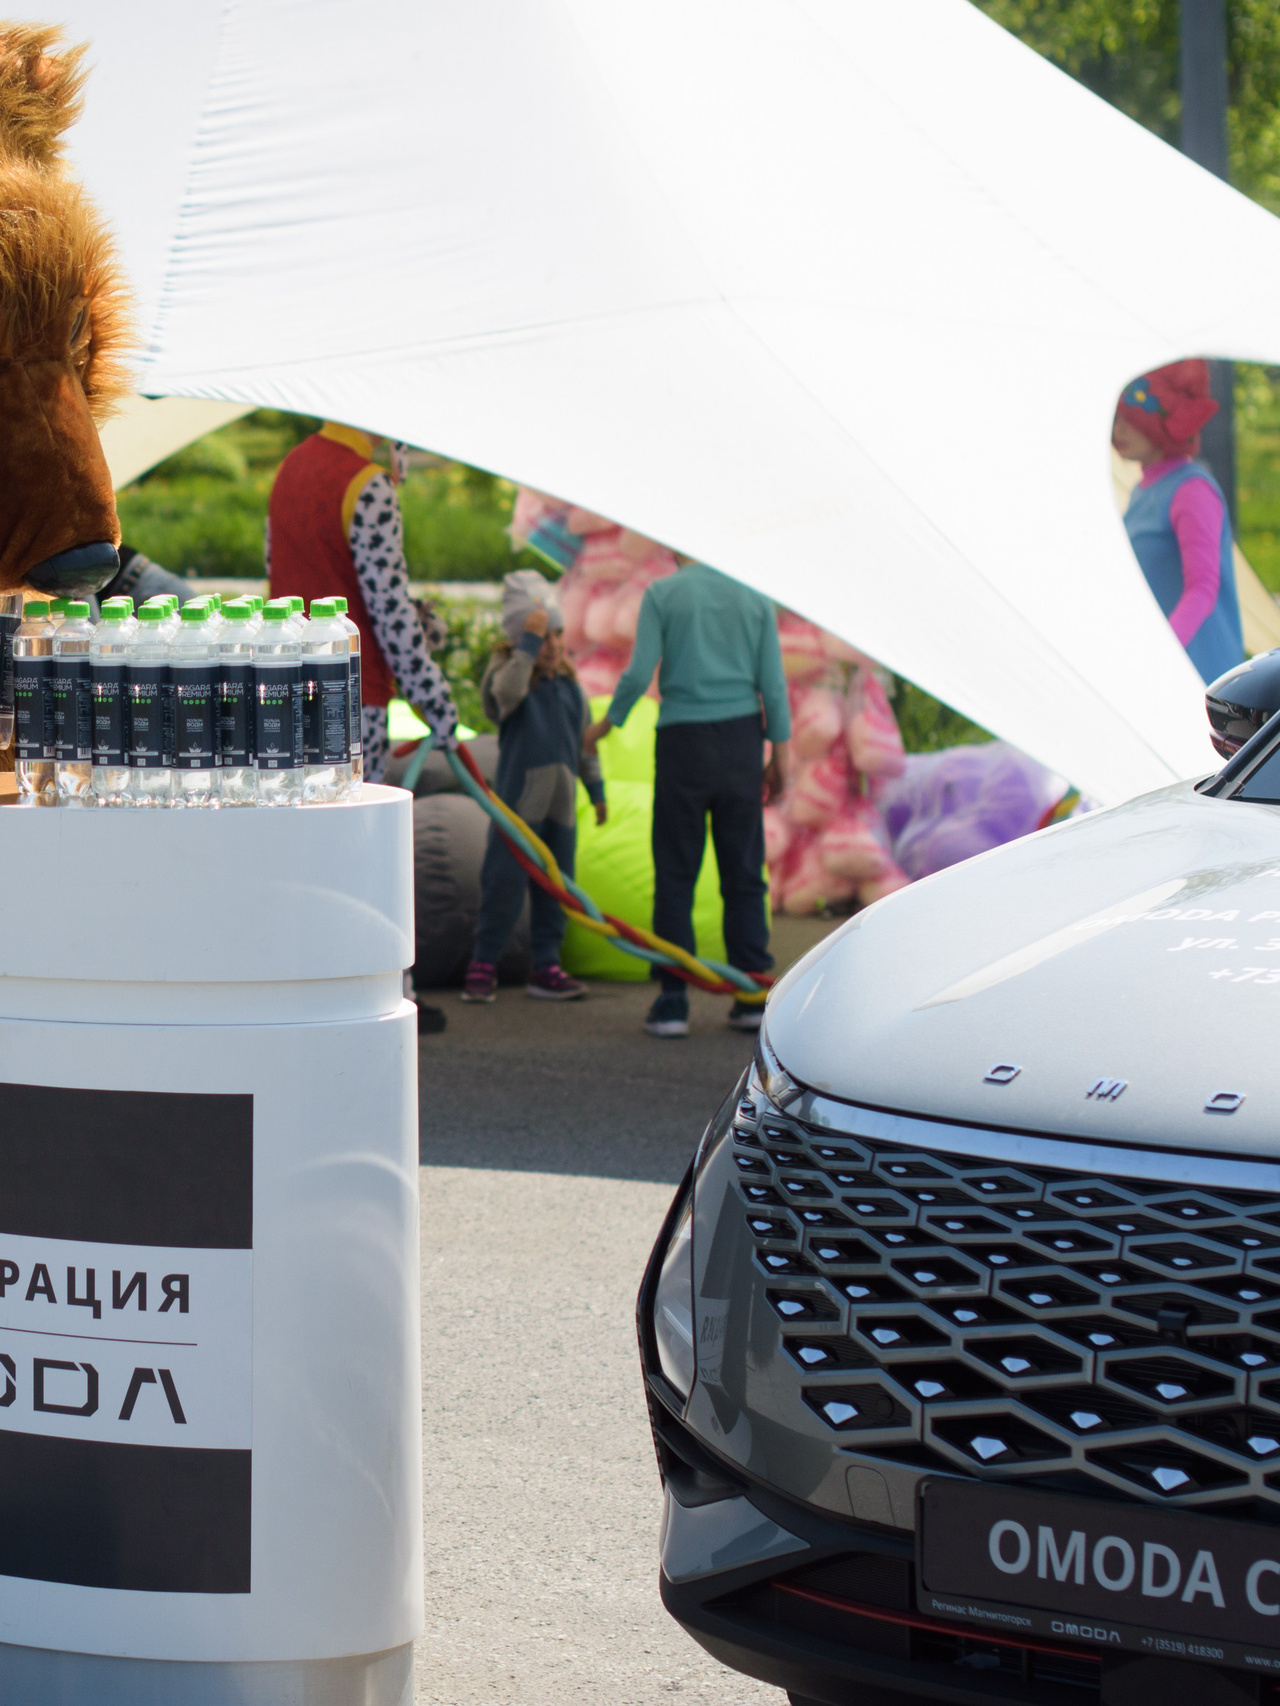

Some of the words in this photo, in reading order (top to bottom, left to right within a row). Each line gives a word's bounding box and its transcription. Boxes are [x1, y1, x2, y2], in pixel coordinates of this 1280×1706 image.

[256, 684, 289, 692] NGARA
[988, 1519, 1226, 1608] OMODA
[968, 1606, 1032, 1627] Магнитогорск
[1051, 1620, 1121, 1643] OMODA
[1141, 1637, 1153, 1647] +7
[1155, 1638, 1186, 1655] (3519)
[1188, 1644, 1224, 1660] 418300
